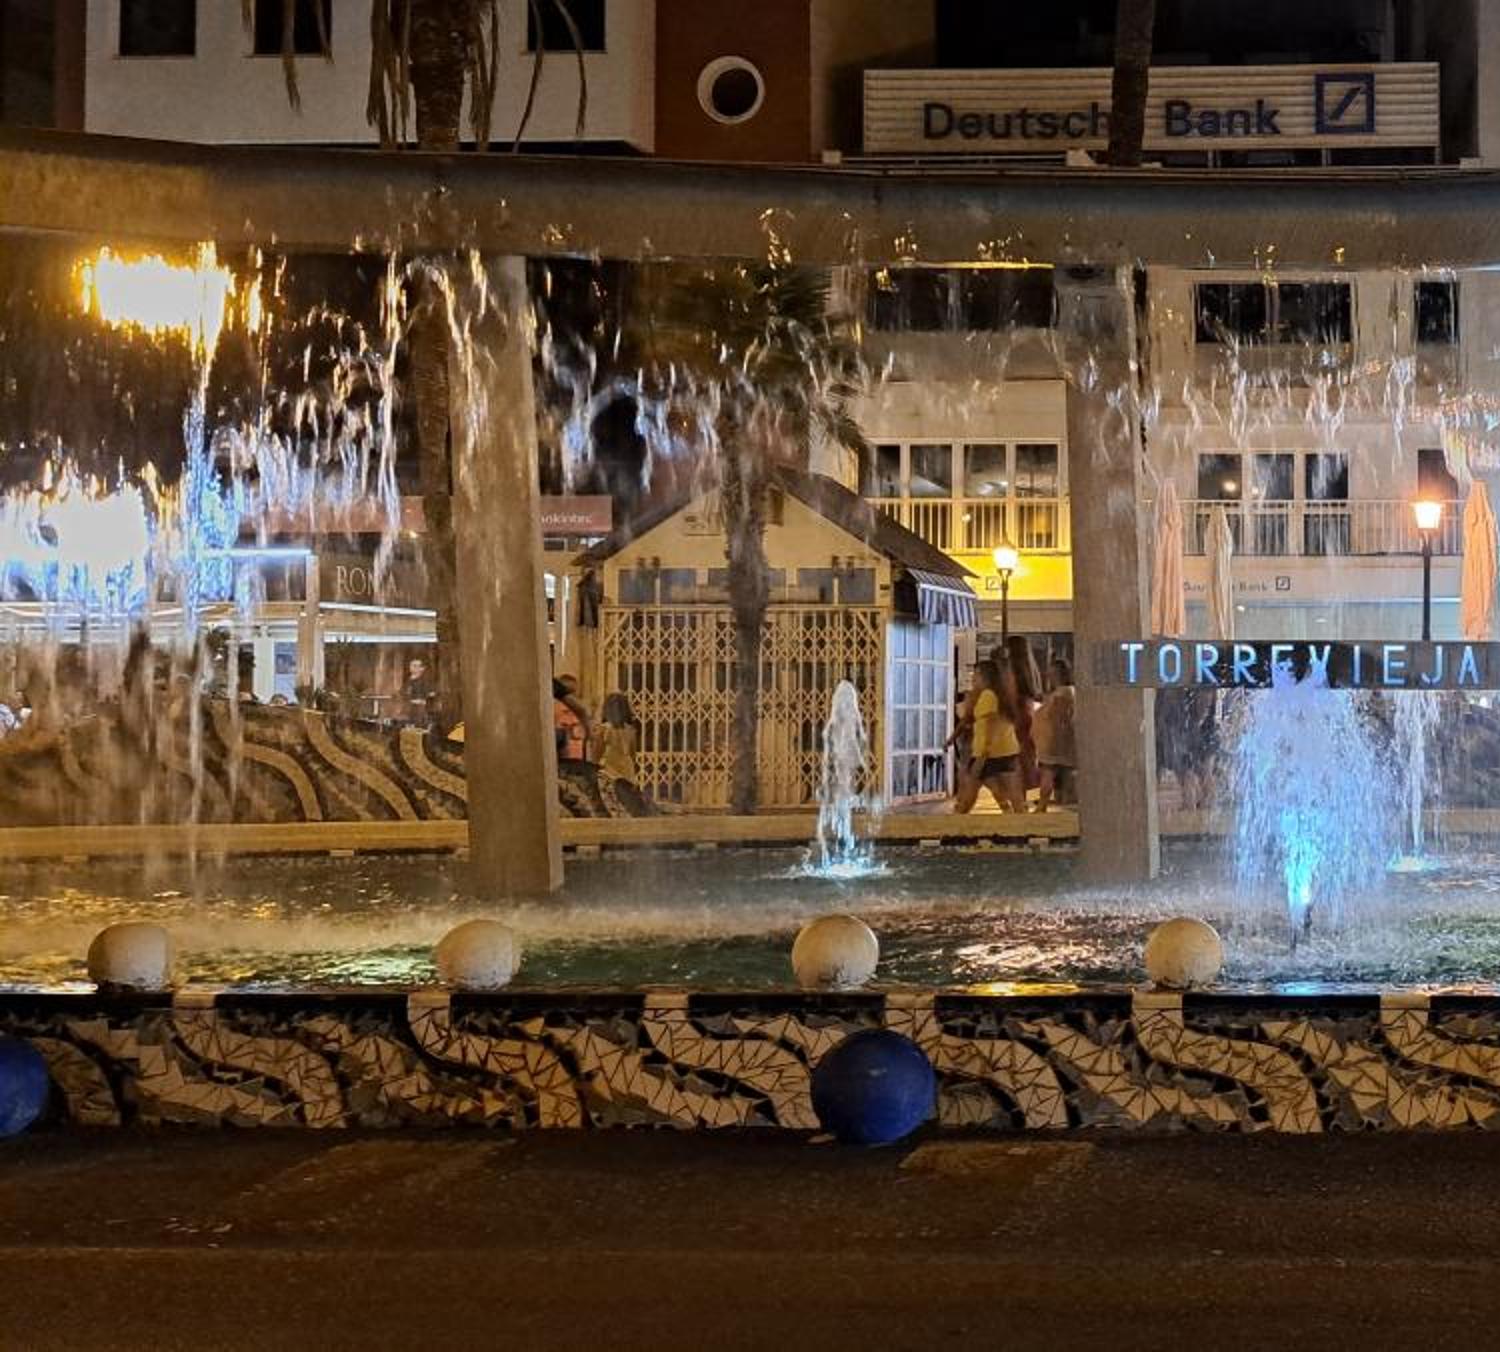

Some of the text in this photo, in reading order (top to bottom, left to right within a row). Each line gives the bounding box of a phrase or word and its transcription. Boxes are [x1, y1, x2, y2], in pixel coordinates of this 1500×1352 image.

[923, 99, 1281, 140] Deutsch Bank
[1120, 642, 1481, 685] TORREVIEJA
